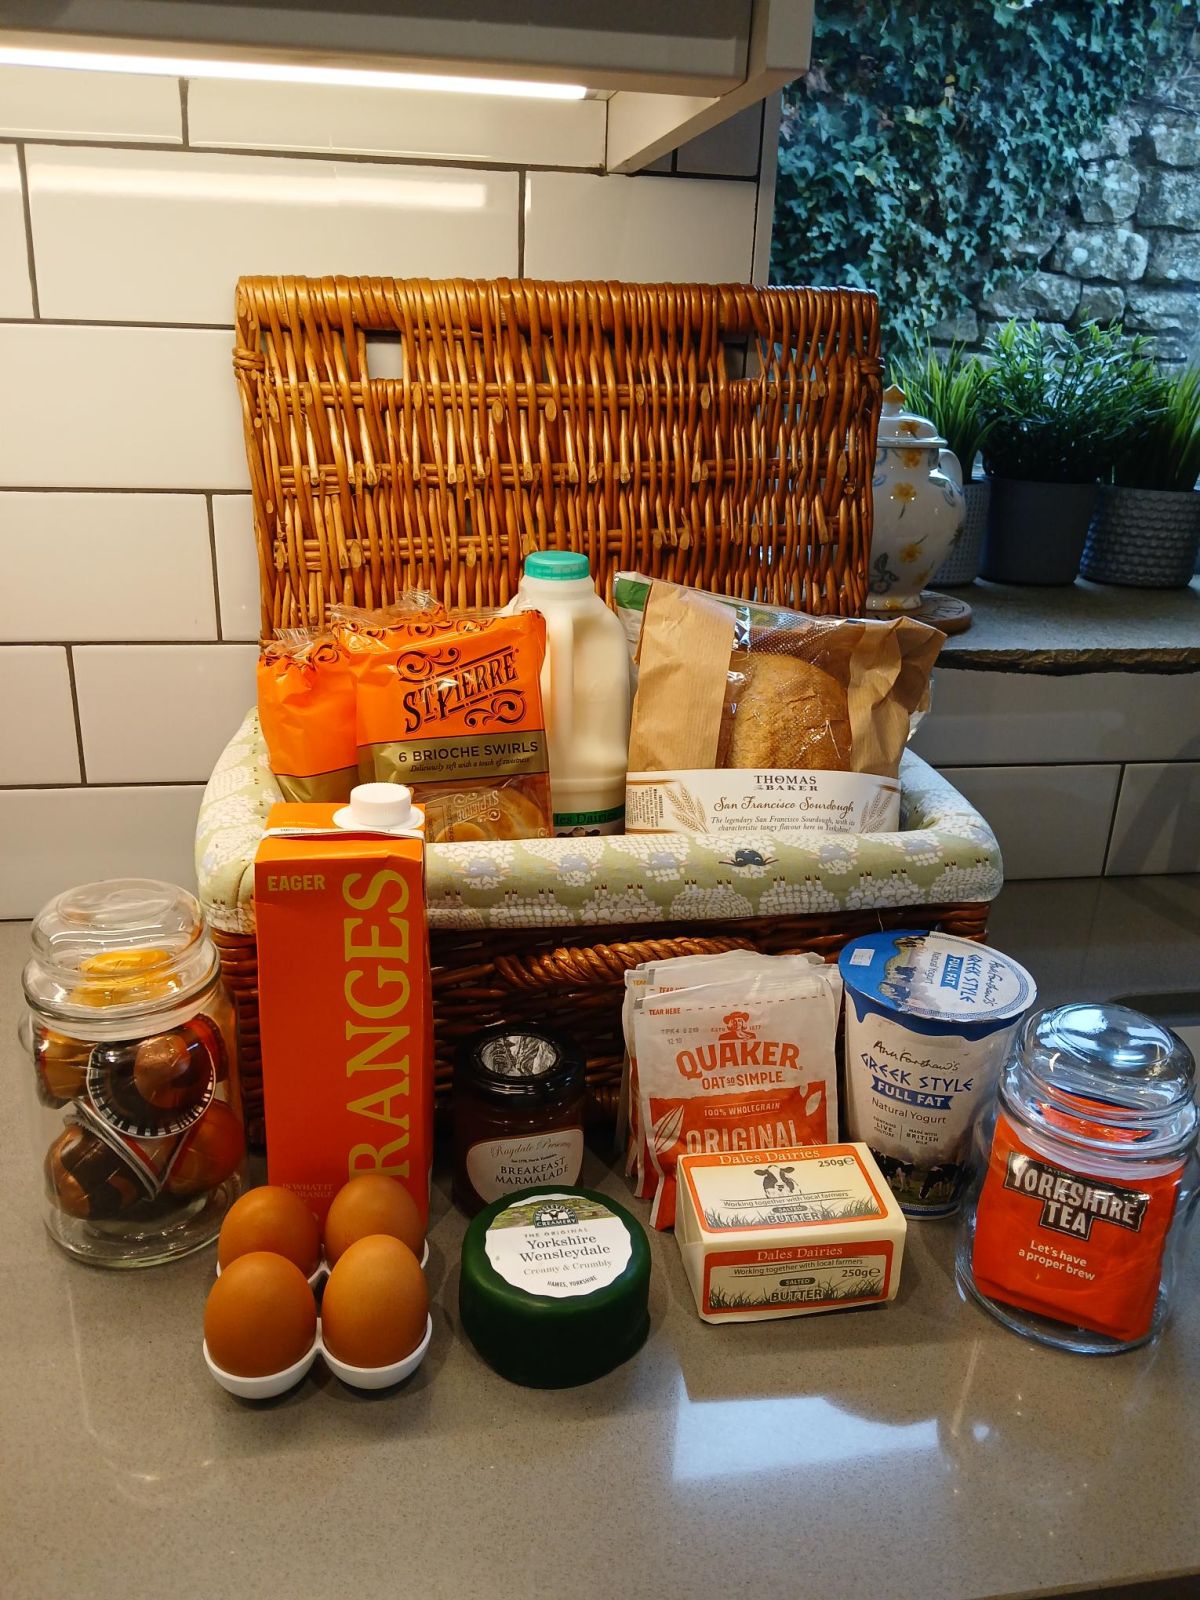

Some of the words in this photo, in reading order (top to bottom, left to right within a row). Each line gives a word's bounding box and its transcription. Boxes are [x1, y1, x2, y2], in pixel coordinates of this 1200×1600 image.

[398, 751, 408, 763] 6
[413, 745, 480, 762] BRIOCHE
[484, 741, 538, 756] SWIRLS
[754, 775, 817, 785] THOMAS
[713, 796, 738, 812] San
[740, 795, 796, 810] Francisco
[799, 796, 854, 819] Sourdough
[718, 823, 758, 831] characteristic
[760, 823, 777, 832] tangy
[725, 816, 753, 825] legendary
[755, 815, 772, 823] San
[774, 815, 799, 823] Francisco
[267, 874, 326, 892] EAGER
[947, 957, 960, 973] FULL
[944, 973, 957, 986] FAT
[665, 1007, 681, 1015] HERE
[341, 868, 411, 1182] RANGES
[676, 1041, 800, 1080] QUAKER
[701, 1075, 726, 1090] OAT
[736, 1071, 784, 1087] SIMPLE
[861, 1053, 912, 1086] GREEK
[919, 1076, 974, 1093] STYLE
[877, 1081, 912, 1102] FULL
[917, 1094, 945, 1107] FAT
[704, 1108, 727, 1116] 100%
[729, 1102, 780, 1115] WHOLEGRAIN
[872, 1097, 908, 1118] Natural
[910, 1111, 947, 1124] Yogurt
[874, 1127, 895, 1138] CULTURE
[876, 1122, 893, 1133] LIVE
[686, 1119, 803, 1155] ORIGINAL
[906, 1133, 939, 1143] BRITISH
[720, 1154, 762, 1165] Dales
[766, 1149, 820, 1161] Dairies
[500, 1157, 566, 1175] BREAKFAST
[495, 1164, 569, 1185] MARMALADE
[1012, 1158, 1139, 1224] YORKSHIRE
[723, 1200, 754, 1208] Working
[754, 1198, 786, 1207] together
[787, 1195, 802, 1203] with
[820, 1191, 849, 1199] farmers
[536, 1219, 576, 1227] CREAMERY
[767, 1212, 822, 1224] BUTTER
[1047, 1200, 1087, 1235] TEA
[527, 1235, 597, 1250] Yorkshire
[520, 1244, 611, 1263] Wensleydale
[757, 1250, 793, 1261] Dales
[797, 1246, 843, 1258] Dairies
[1030, 1240, 1058, 1257] Let's
[1060, 1251, 1087, 1267] have
[523, 1265, 560, 1276] Creamy
[562, 1263, 570, 1271] &
[733, 1267, 765, 1276] Working
[765, 1263, 798, 1273] together
[799, 1261, 816, 1269] with
[1019, 1249, 1025, 1257] a
[1026, 1251, 1065, 1270] proper
[1066, 1263, 1096, 1281] brew
[771, 1289, 823, 1302] BUTTER
